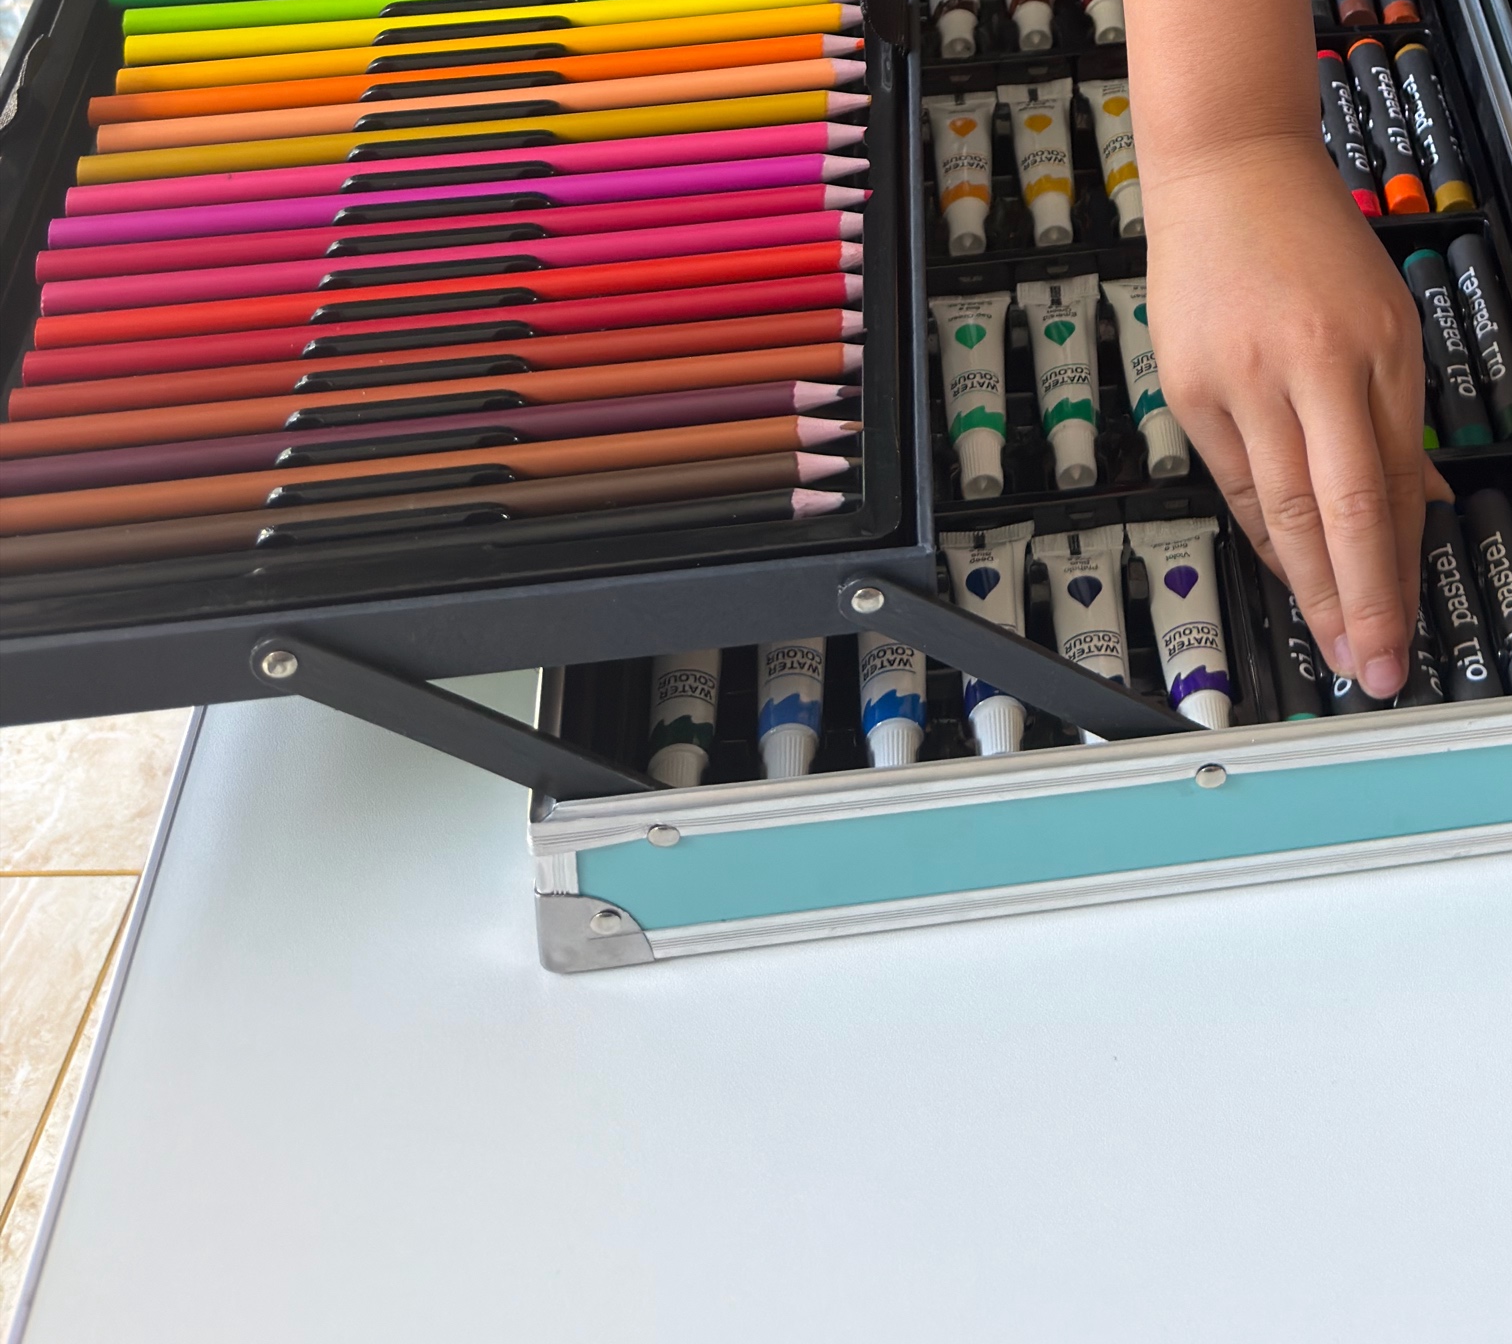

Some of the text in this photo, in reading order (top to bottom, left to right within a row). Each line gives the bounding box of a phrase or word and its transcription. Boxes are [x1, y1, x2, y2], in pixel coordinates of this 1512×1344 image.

[1371, 66, 1413, 156] oil pastel
[1331, 81, 1370, 172] oil pastel
[1103, 135, 1133, 154] LOUR
[1105, 142, 1134, 158] ATER
[943, 154, 988, 167] COLOUR
[1021, 150, 1066, 164] COLOUR
[1023, 154, 1066, 171] WATER
[945, 160, 987, 173] WATER
[1458, 266, 1499, 340] pastel
[1425, 286, 1477, 397] oil pastel
[1132, 353, 1155, 369] OUR
[1136, 362, 1158, 376] TER
[950, 372, 999, 390] COLOUR
[1040, 367, 1091, 385] COLOUR
[1043, 375, 1090, 393] WATER
[952, 379, 998, 396] WATER
[1166, 552, 1190, 561] Violet
[1429, 542, 1488, 681] oil pastel
[1064, 634, 1121, 654] COLOUR
[1163, 626, 1218, 647] COLOUR
[1067, 643, 1120, 661] WATER
[1168, 636, 1218, 656] WATER
[766, 650, 822, 665] COLOUR
[861, 647, 915, 672] COLOUR
[1288, 638, 1316, 681] oil
[768, 661, 820, 679] WATER
[863, 657, 912, 681] WATER
[658, 673, 716, 690] COLOUR
[659, 683, 712, 700] WATER
